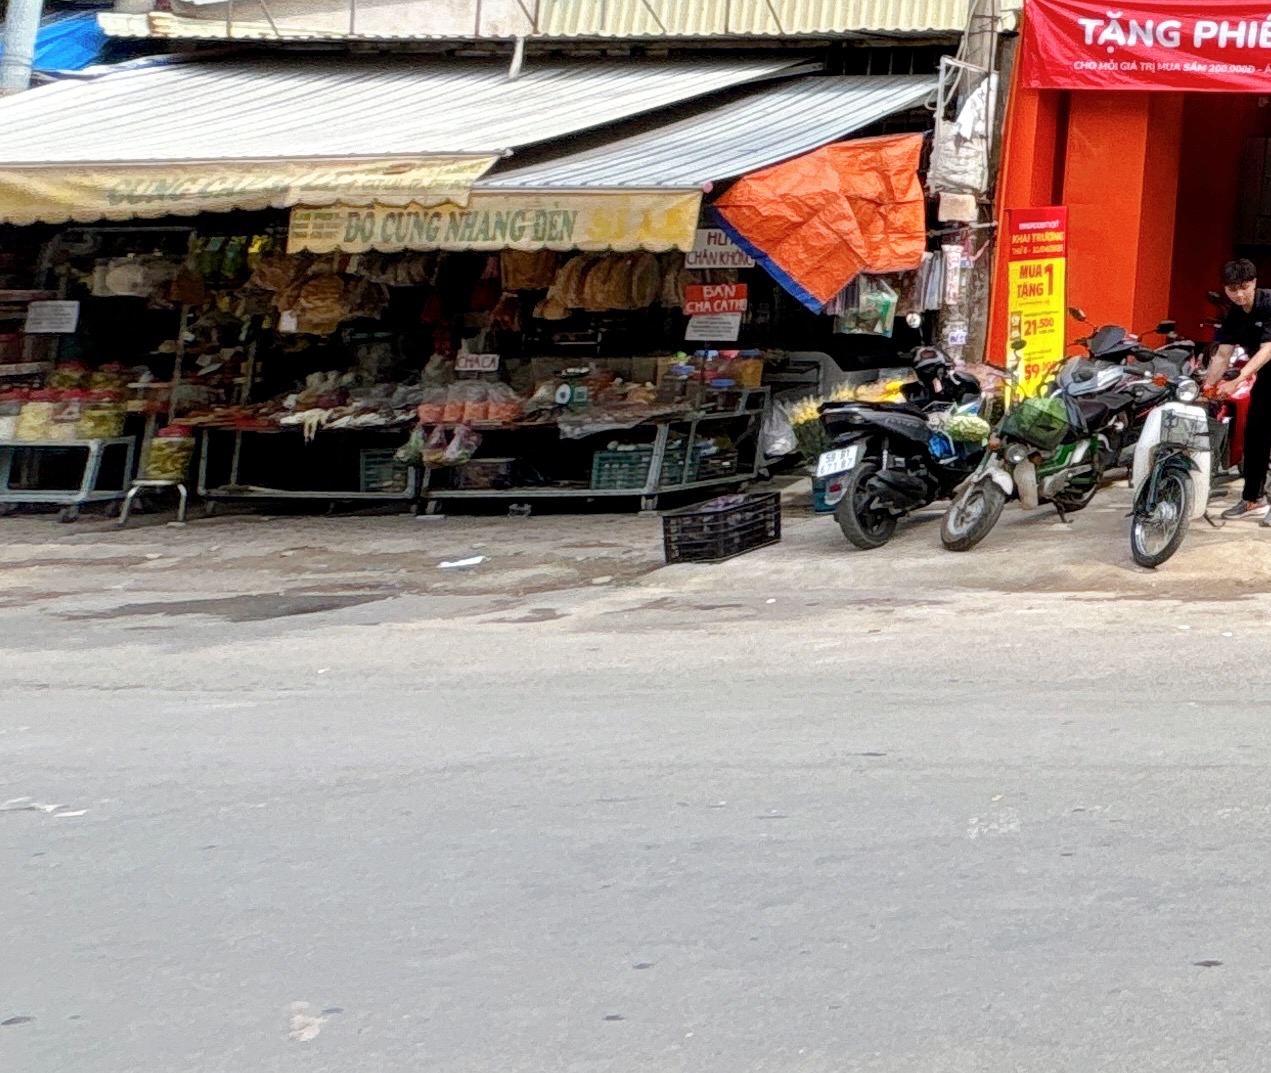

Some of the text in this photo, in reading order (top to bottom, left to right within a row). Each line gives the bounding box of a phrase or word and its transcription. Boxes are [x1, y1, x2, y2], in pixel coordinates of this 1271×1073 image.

[1077, 11, 1182, 53] TẶNG
[1019, 264, 1042, 279] MUA
[1044, 263, 1054, 295] 1
